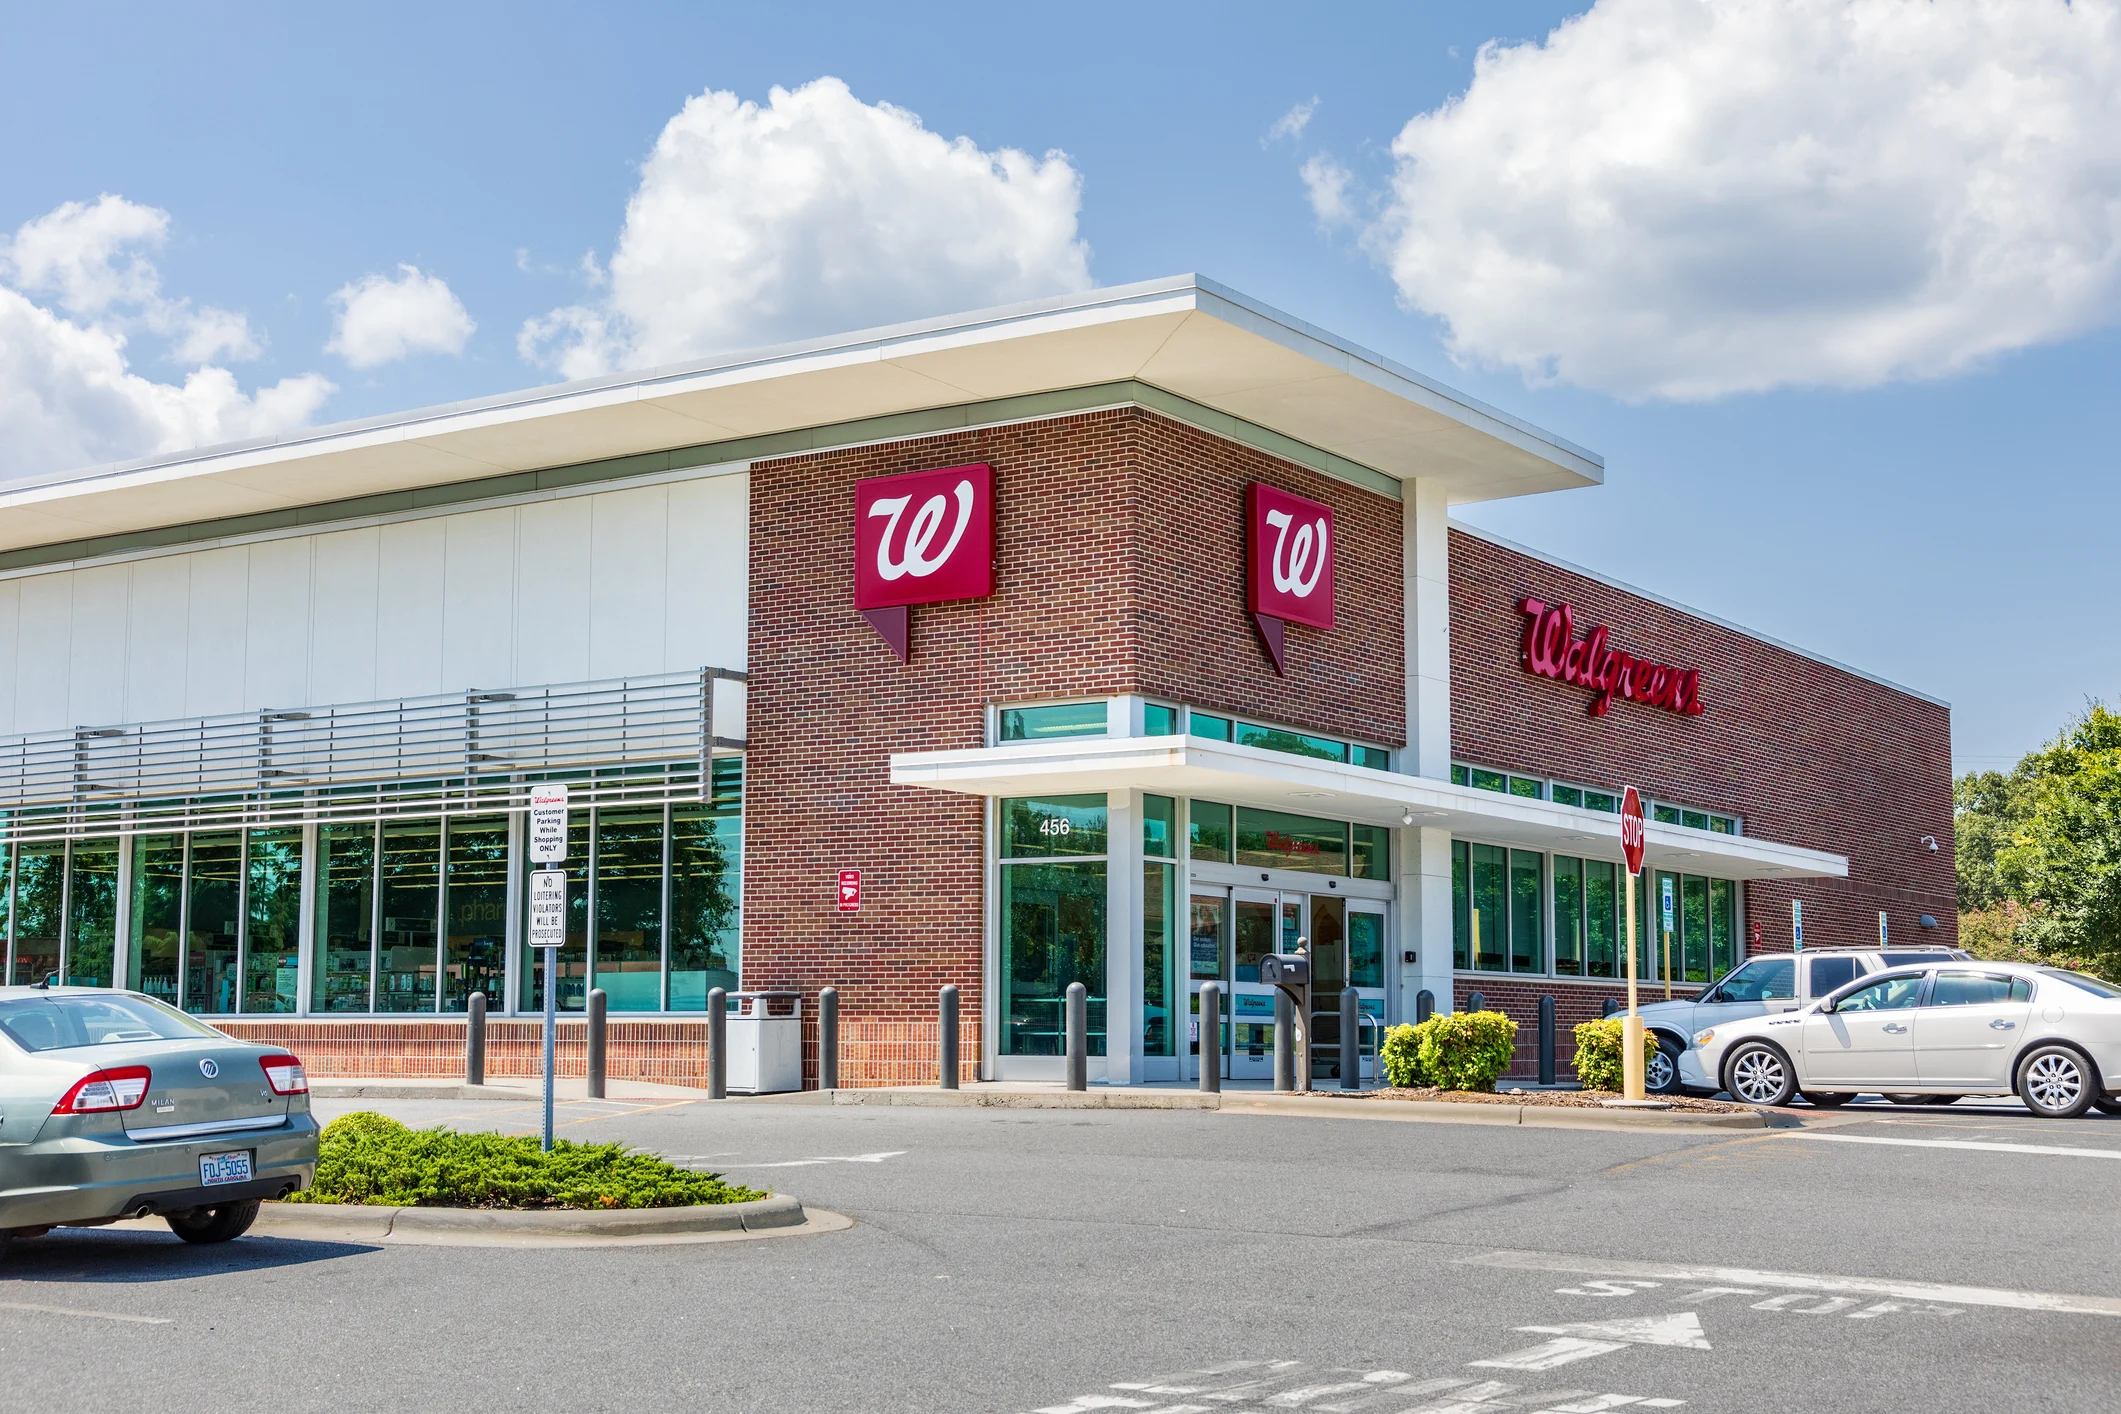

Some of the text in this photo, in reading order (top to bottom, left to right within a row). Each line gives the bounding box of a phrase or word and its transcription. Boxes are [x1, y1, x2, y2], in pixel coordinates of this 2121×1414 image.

[868, 480, 974, 581] W
[1266, 509, 1327, 598] W
[1518, 598, 1704, 717] Walgreens
[534, 796, 564, 805] Walgreens
[1040, 818, 1070, 836] 456
[1623, 812, 1643, 848] STOP
[533, 836, 563, 844] Shopping
[1265, 831, 1320, 857] Walgreens
[543, 878, 553, 888] NO
[534, 890, 562, 900] LOITERING
[461, 898, 506, 928] phar
[533, 903, 562, 913] VIOLATORS
[536, 916, 558, 926] WILL BE
[532, 929, 562, 938] PROSECUTED
[151, 1098, 175, 1106] MILAN
[203, 1159, 249, 1178] FDJ-5055
[224, 1174, 247, 1182] CAROLINA
[1553, 1279, 1968, 1319] STOP
